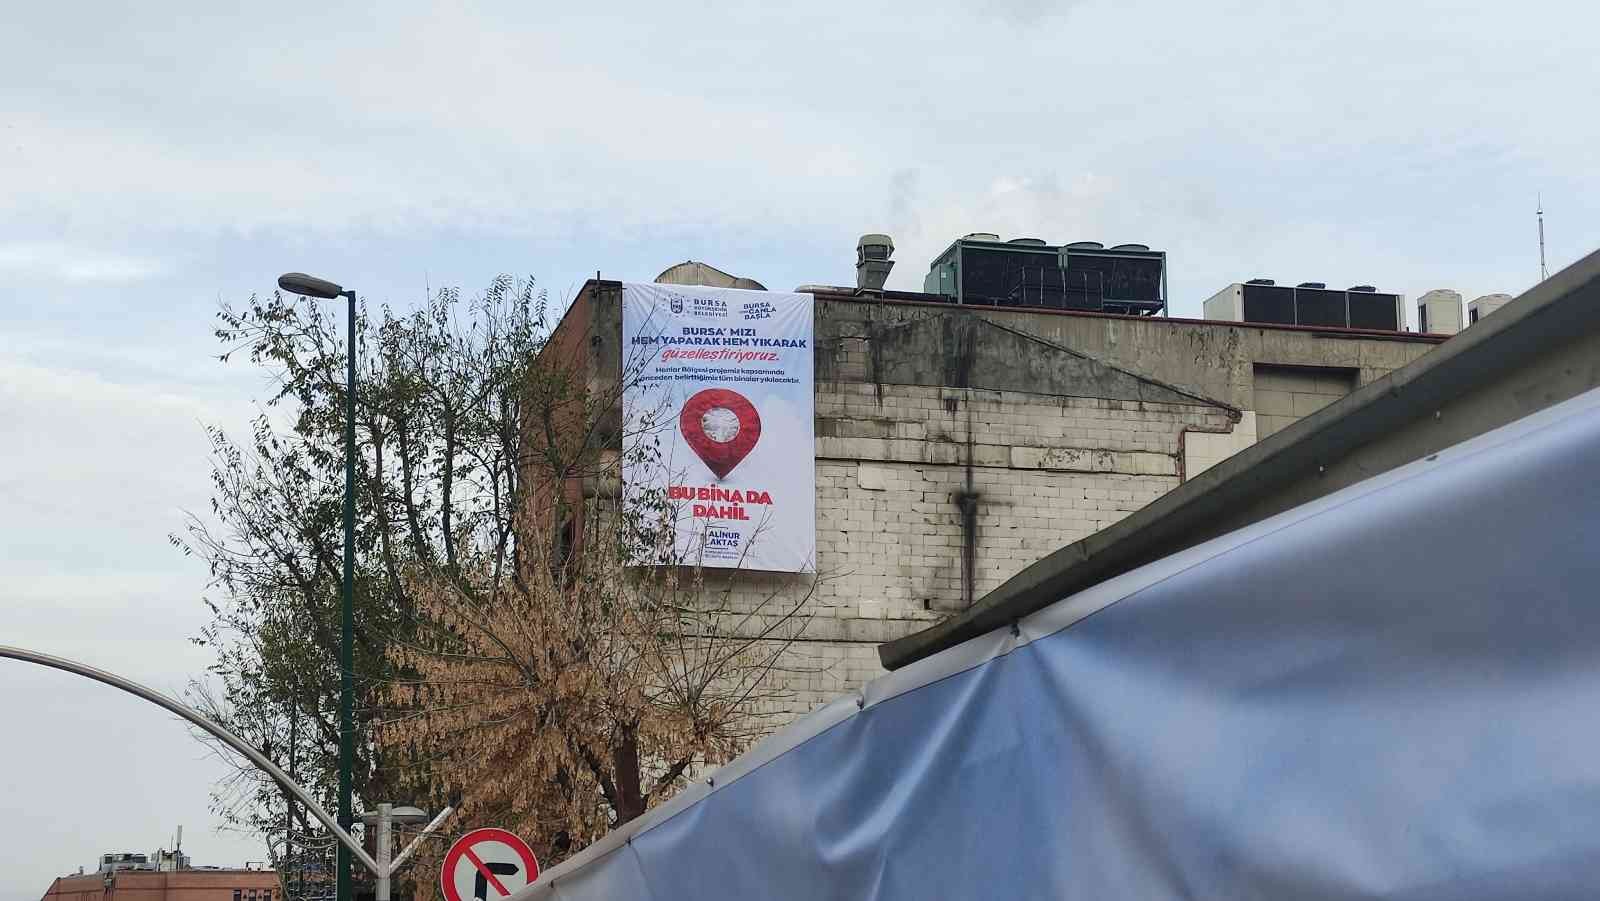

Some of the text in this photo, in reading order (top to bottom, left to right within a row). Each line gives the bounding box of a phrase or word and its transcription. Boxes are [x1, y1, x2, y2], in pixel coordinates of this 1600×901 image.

[694, 299, 727, 307] BURSA
[743, 302, 771, 310] BURSA
[631, 336, 807, 348] HEM YAPARAK HEM YIKARAK
[668, 484, 773, 505] BU BİNA DA
[693, 502, 749, 520] DAHİL
